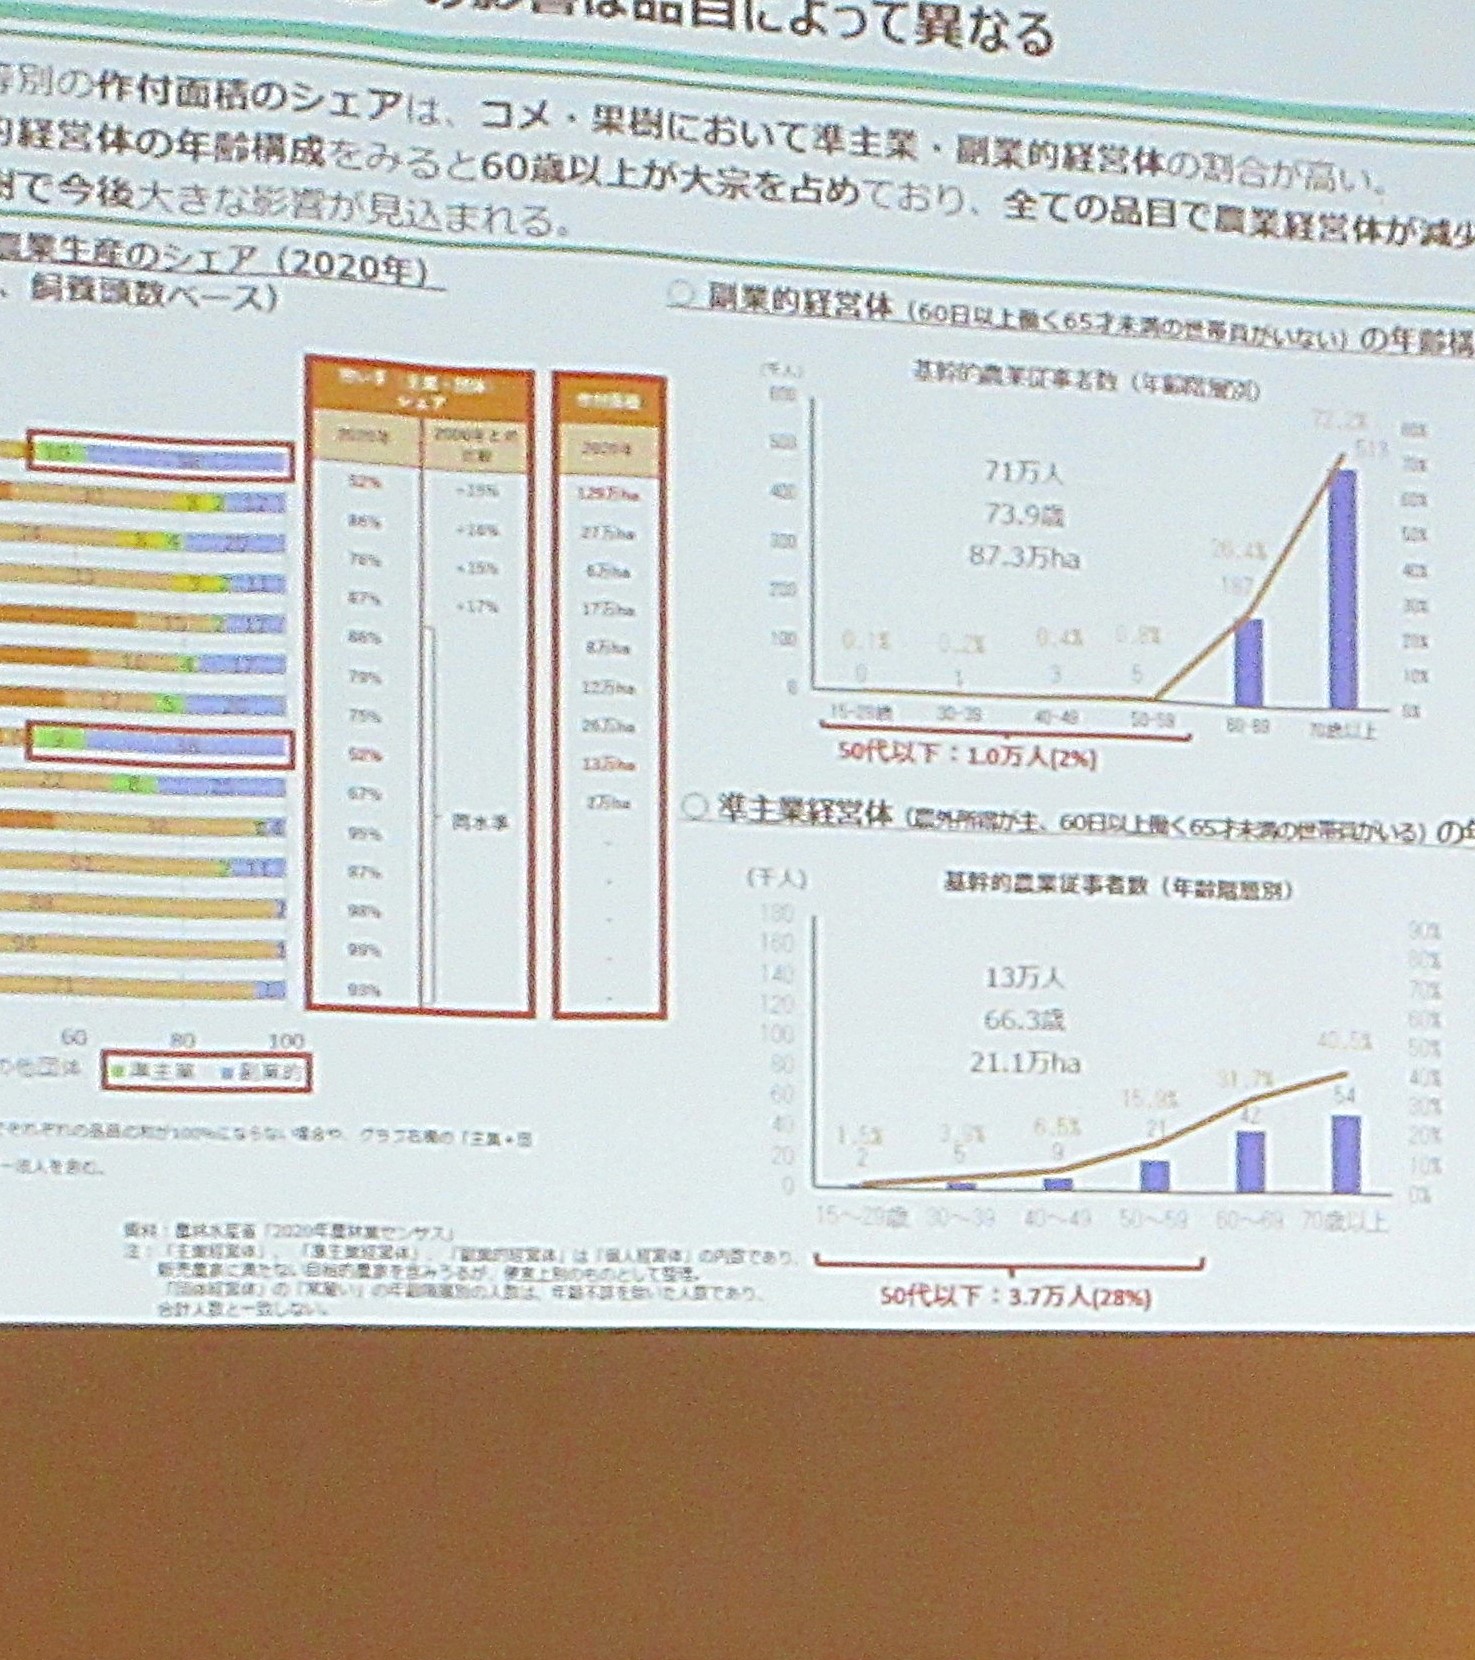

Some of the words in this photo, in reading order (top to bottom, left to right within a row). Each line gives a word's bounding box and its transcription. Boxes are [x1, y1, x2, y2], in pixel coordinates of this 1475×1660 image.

[985, 459, 1063, 486] 71万人
[969, 544, 1081, 570] 87.3万ha
[987, 966, 1065, 990] 13万人
[969, 1051, 1082, 1075] 21.1万ha
